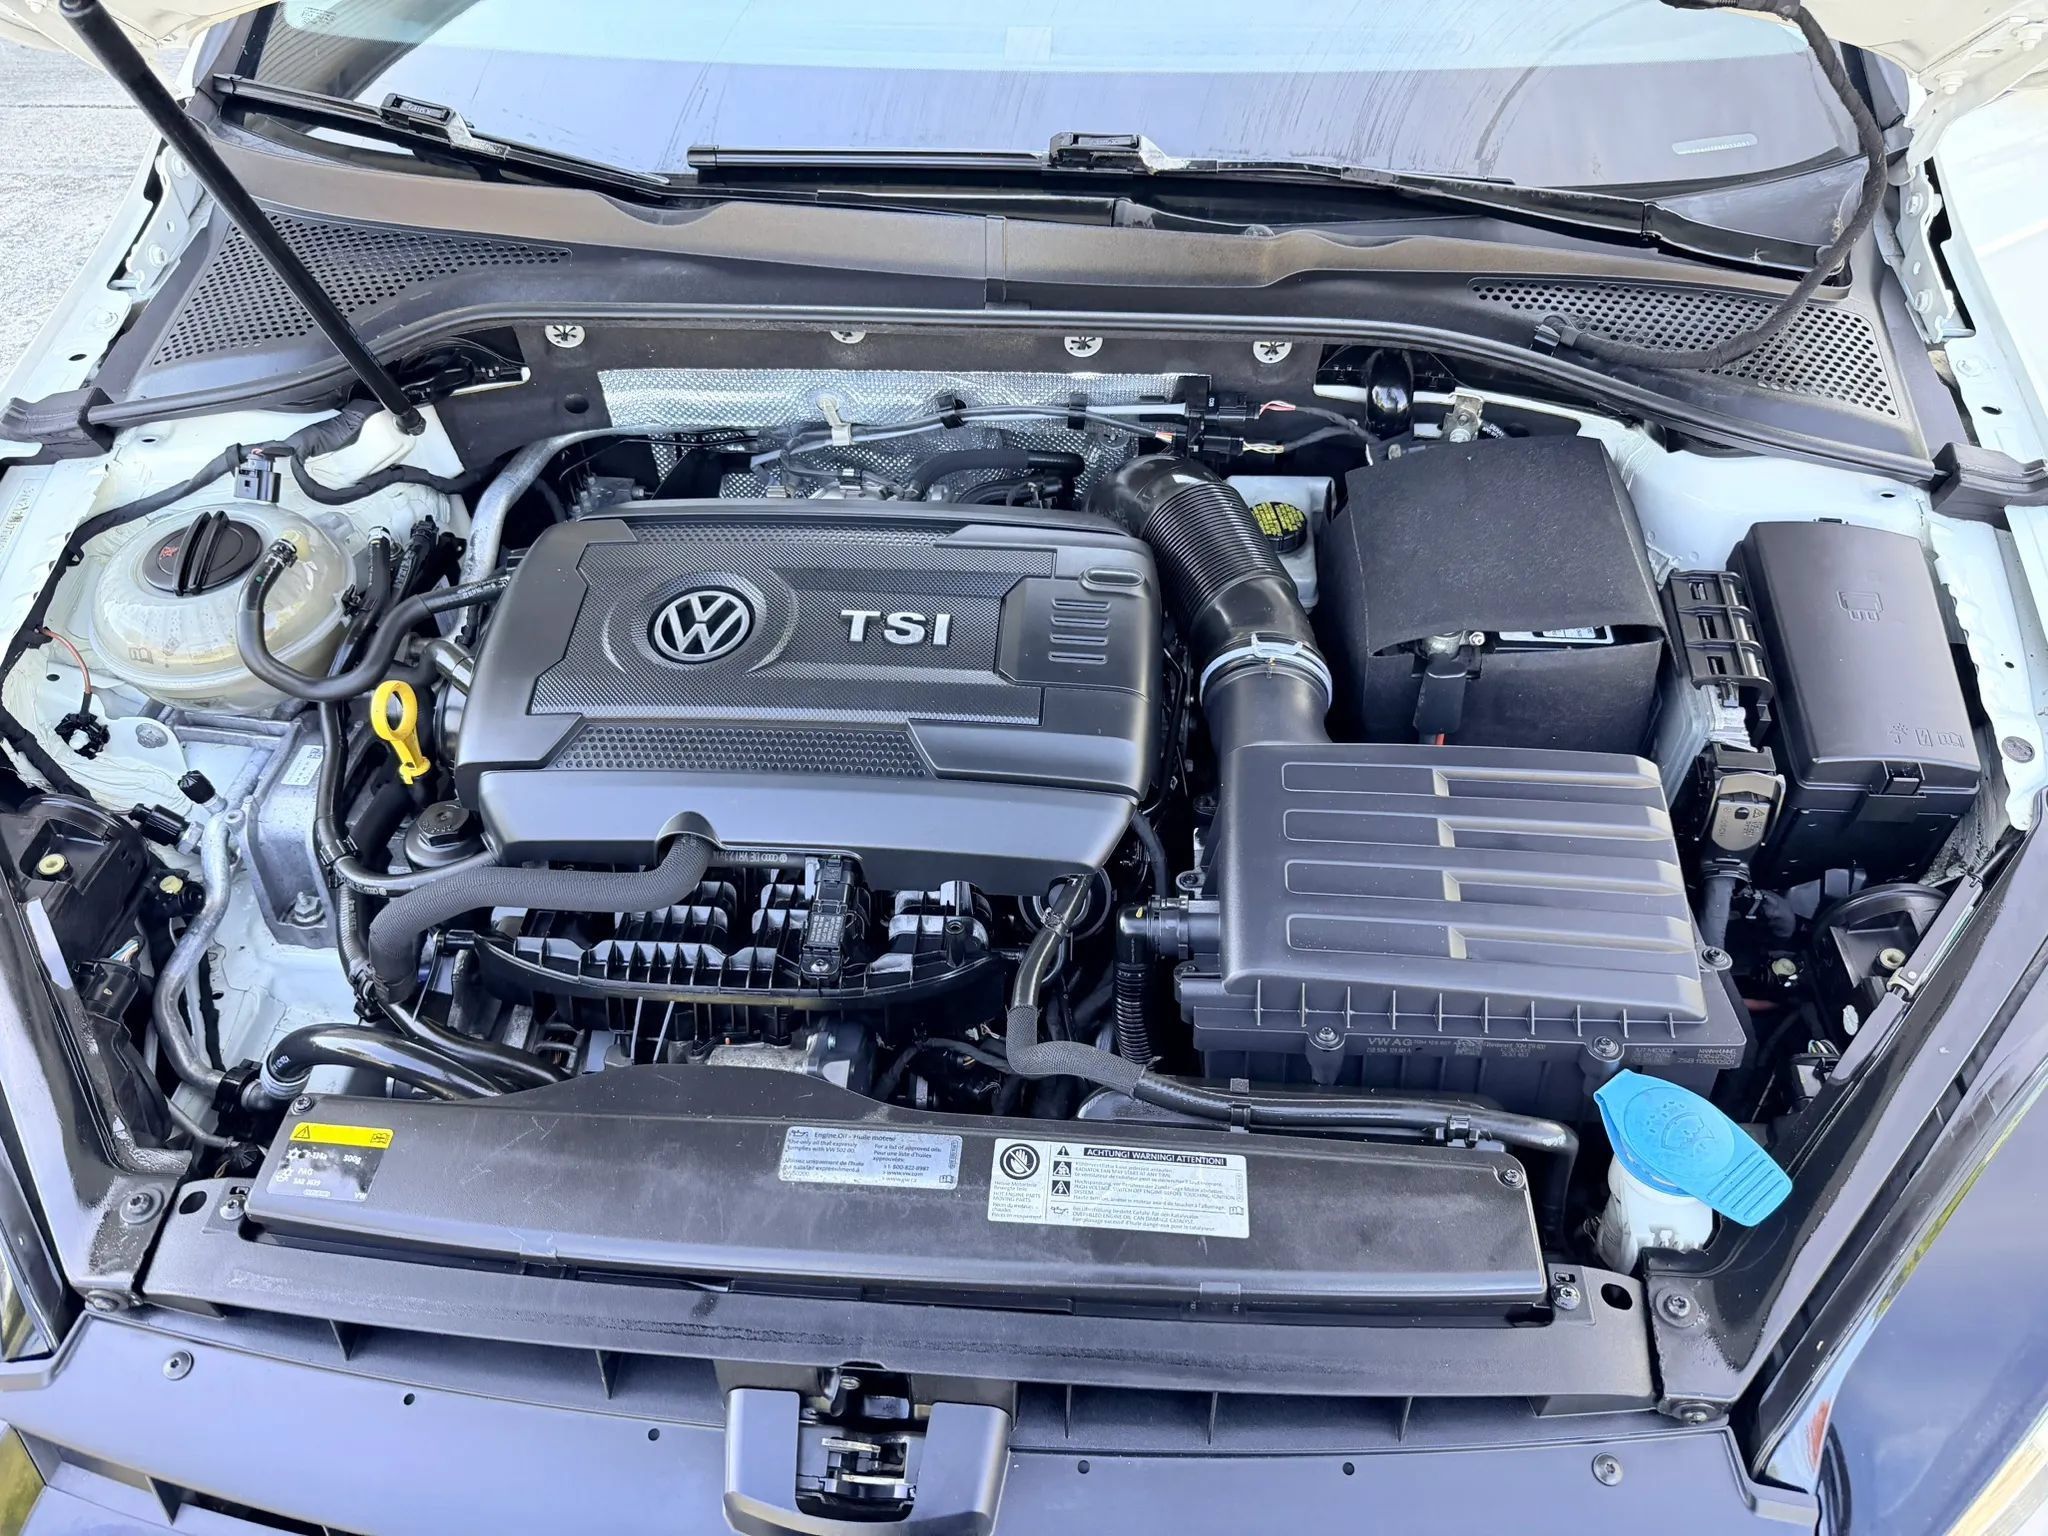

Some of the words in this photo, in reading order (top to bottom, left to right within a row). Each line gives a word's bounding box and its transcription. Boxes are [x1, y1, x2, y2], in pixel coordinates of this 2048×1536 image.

[840, 609, 952, 647] TSI
[1368, 1038, 1392, 1046] VW
[1393, 1038, 1412, 1046] AG
[1087, 1149, 1130, 1158] ACHTUNG!
[1131, 1153, 1175, 1162] WARNING!
[1176, 1156, 1224, 1166] ATTENTION!
